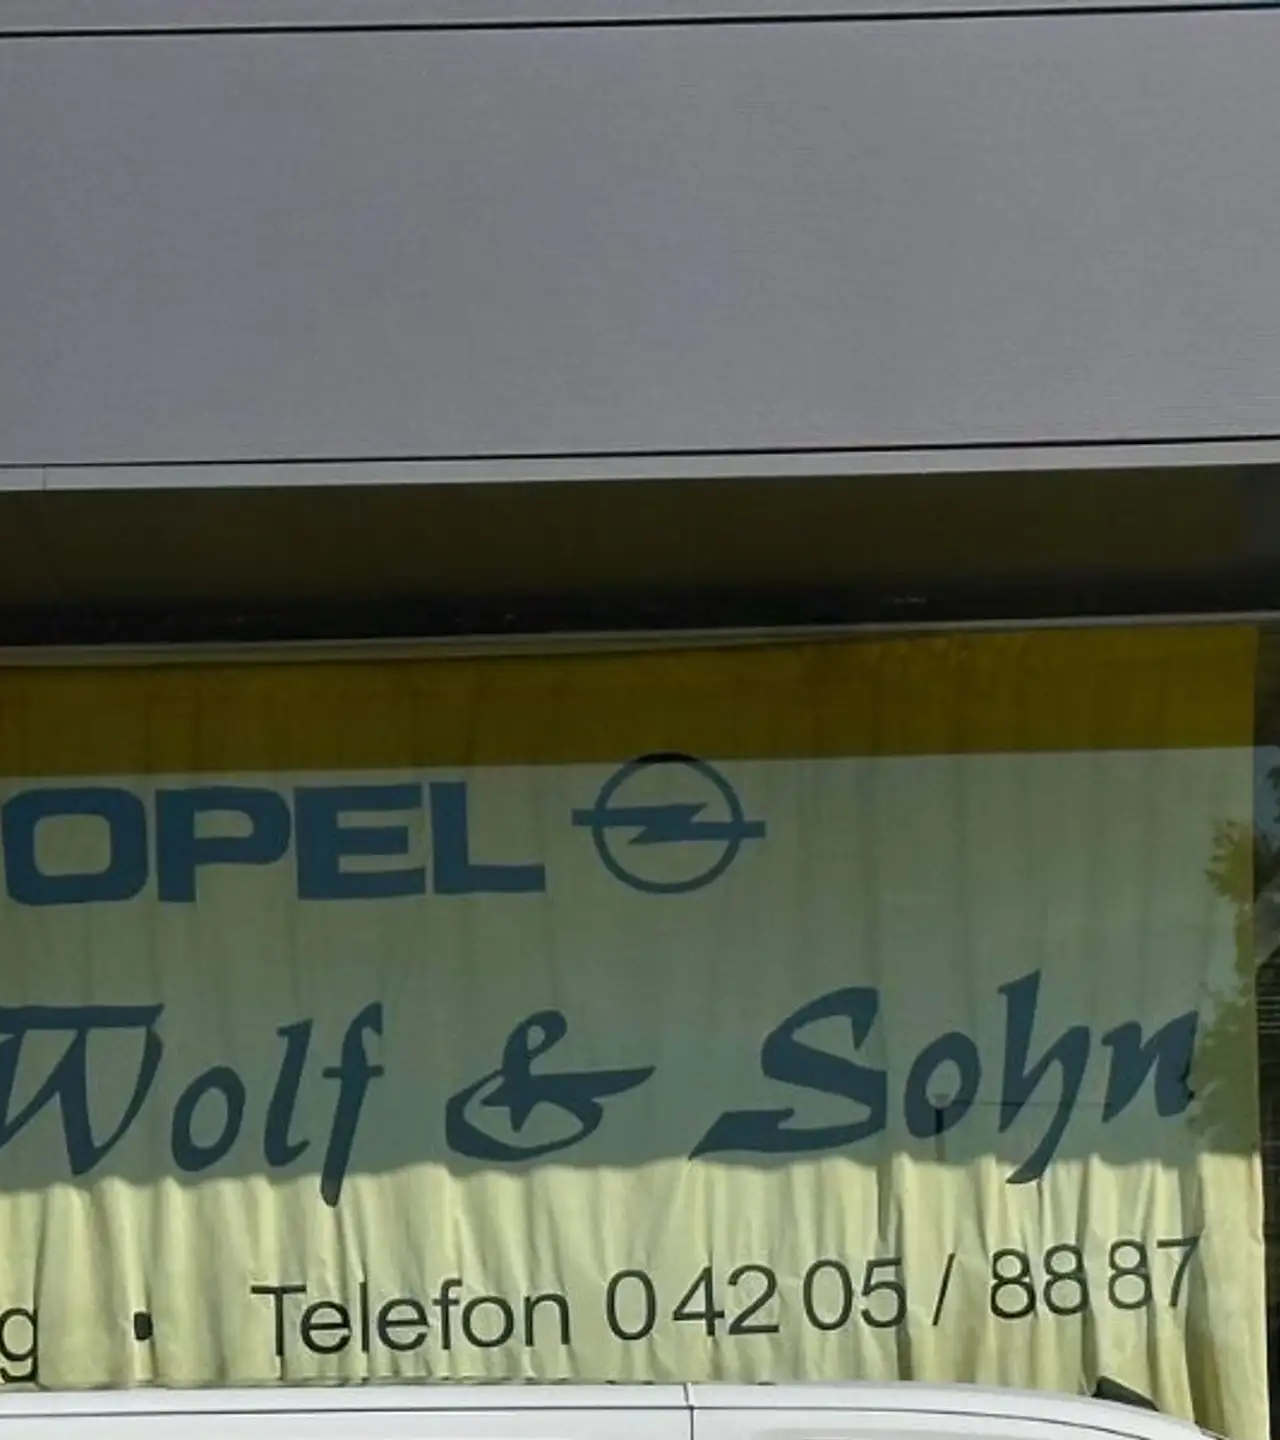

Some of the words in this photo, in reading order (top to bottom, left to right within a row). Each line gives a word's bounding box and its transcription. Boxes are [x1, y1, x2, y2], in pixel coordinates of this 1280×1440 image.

[0, 780, 547, 907] OPEL
[444, 1008, 657, 1163] &
[688, 968, 1199, 1185] Sohn
[249, 1277, 571, 1357] Telefon
